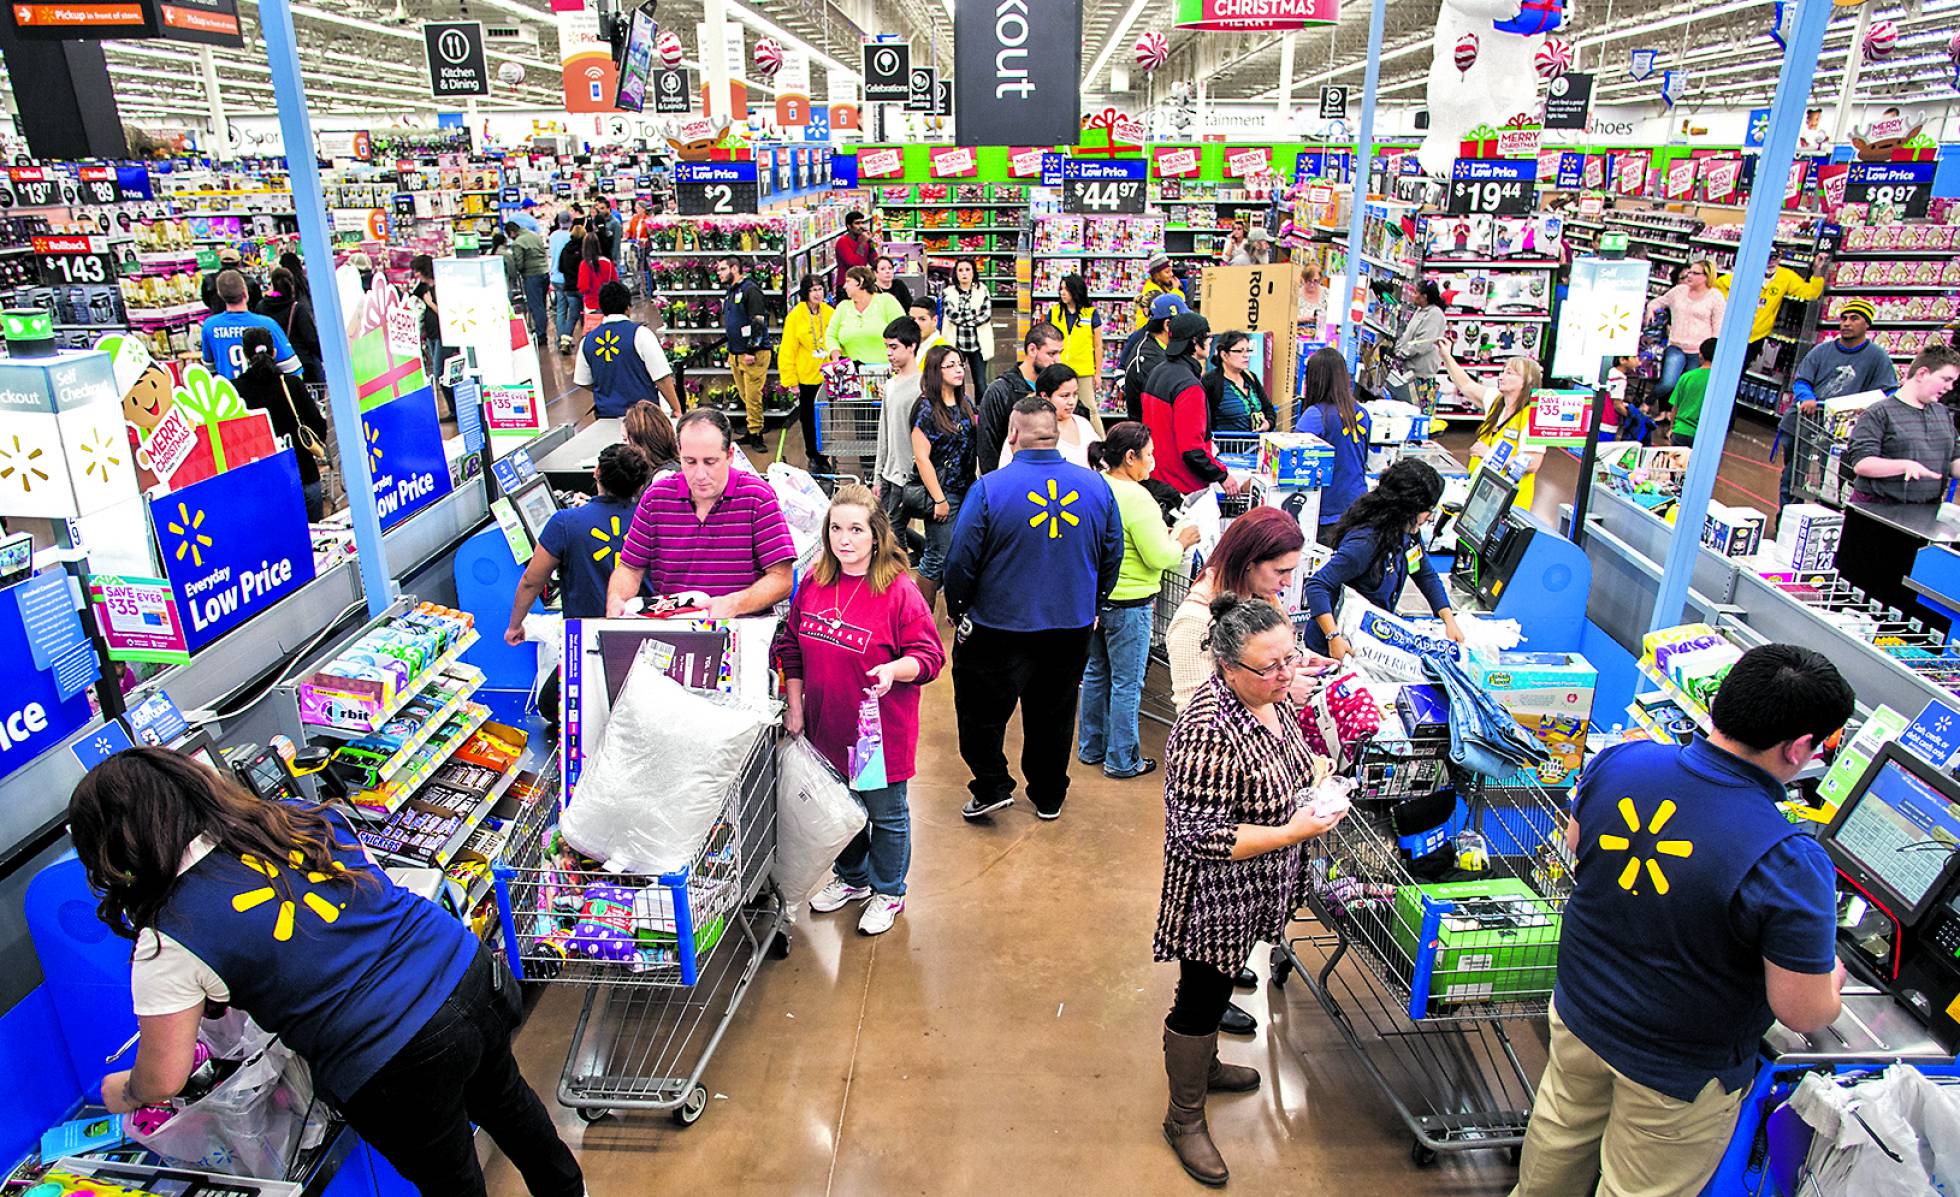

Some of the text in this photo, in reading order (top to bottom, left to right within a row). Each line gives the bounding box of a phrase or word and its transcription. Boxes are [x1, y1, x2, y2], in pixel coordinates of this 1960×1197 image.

[1213, 0, 1316, 16] CHRISTMAS
[54, 9, 86, 21] Pickup
[440, 68, 476, 79] Kitchen
[440, 79, 480, 92] & Dining
[865, 83, 910, 93] Celebrations
[681, 121, 710, 132] MERRY
[1115, 123, 1145, 135] MERRY
[1872, 119, 1904, 132] MERRY
[1501, 131, 1540, 143] MERRY
[864, 150, 895, 165] MERRY
[936, 150, 967, 165] MERRY
[1160, 153, 1191, 166] MERRY
[1231, 153, 1261, 166] MERRY
[692, 169, 739, 180] Low Price
[1081, 167, 1128, 177] Low Price
[1471, 166, 1518, 178] Low Price
[1866, 169, 1915, 181] Low Price
[90, 181, 116, 202] $89
[122, 190, 143, 199] Price
[704, 184, 734, 213] $2
[49, 240, 87, 250] Rollback
[46, 255, 105, 283] $143
[228, 344, 249, 379] 9
[56, 368, 78, 386] Self
[0, 390, 41, 405] ckout
[59, 380, 109, 402] Checkout
[493, 399, 511, 409] $35
[1540, 405, 1560, 416] $35
[147, 410, 182, 462] MERRY
[155, 426, 191, 474] CHRISTMAS
[398, 471, 435, 507] Price
[1817, 552, 1836, 570] 23
[184, 565, 231, 599] Everyday
[106, 586, 135, 599] SAVE
[136, 592, 163, 604] EVER
[188, 558, 293, 632] Low Price
[108, 598, 139, 616] $35
[359, 831, 403, 852] SNICKERS
